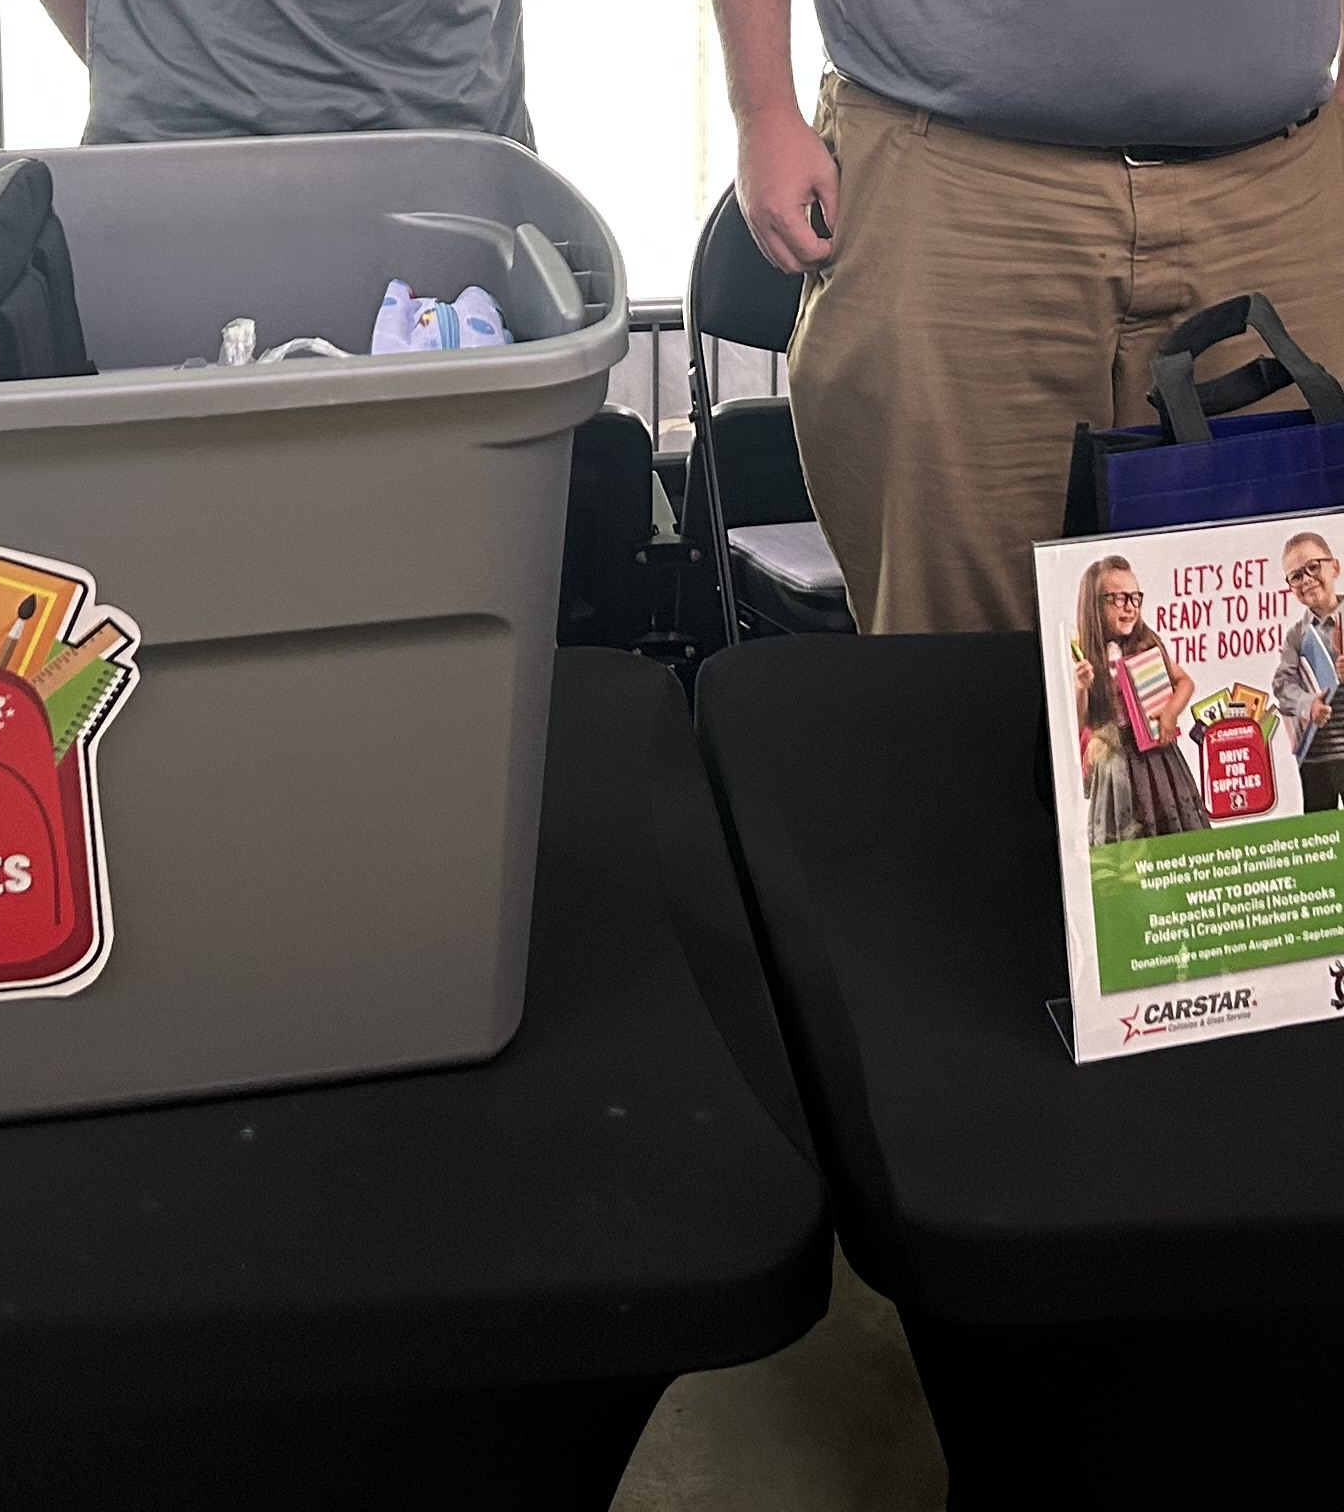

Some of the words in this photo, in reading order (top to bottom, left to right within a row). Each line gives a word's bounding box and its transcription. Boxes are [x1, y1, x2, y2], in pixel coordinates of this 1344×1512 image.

[1173, 565, 1223, 596] LET'S
[1232, 558, 1270, 589] GET
[1157, 601, 1213, 633] READY
[1225, 597, 1249, 624] TO
[1258, 590, 1293, 621] HIT
[1171, 635, 1207, 665] THE
[1217, 623, 1284, 659] BOOKS!
[1219, 747, 1250, 764] DRIVE
[1225, 762, 1246, 777] FOR
[1212, 774, 1262, 794] SUPPLIES
[1135, 859, 1155, 874] We
[1156, 854, 1187, 871] need
[1187, 851, 1215, 868] your
[1216, 846, 1243, 862] help
[1244, 844, 1257, 858] to
[1259, 837, 1300, 855] collect
[1301, 830, 1341, 849] school
[1140, 871, 1191, 891] supplies
[1193, 867, 1211, 881] for
[1212, 861, 1242, 879] local
[1243, 855, 1291, 873] families
[1292, 851, 1304, 865] in
[1304, 847, 1338, 864] need.
[1149, 906, 1215, 928] Backpacks
[1222, 897, 1266, 917] Pencils
[1272, 886, 1336, 907] Notebooks
[1186, 887, 1223, 906] WHAT
[1224, 884, 1242, 899] TO
[1243, 876, 1297, 896] DONATE:
[1144, 926, 1190, 945] Folders
[1196, 917, 1245, 937] Crayons
[1251, 909, 1299, 928] Markers
[1300, 905, 1311, 920] &
[1312, 902, 1343, 917] more
[1144, 987, 1252, 1025] CARSTAR
